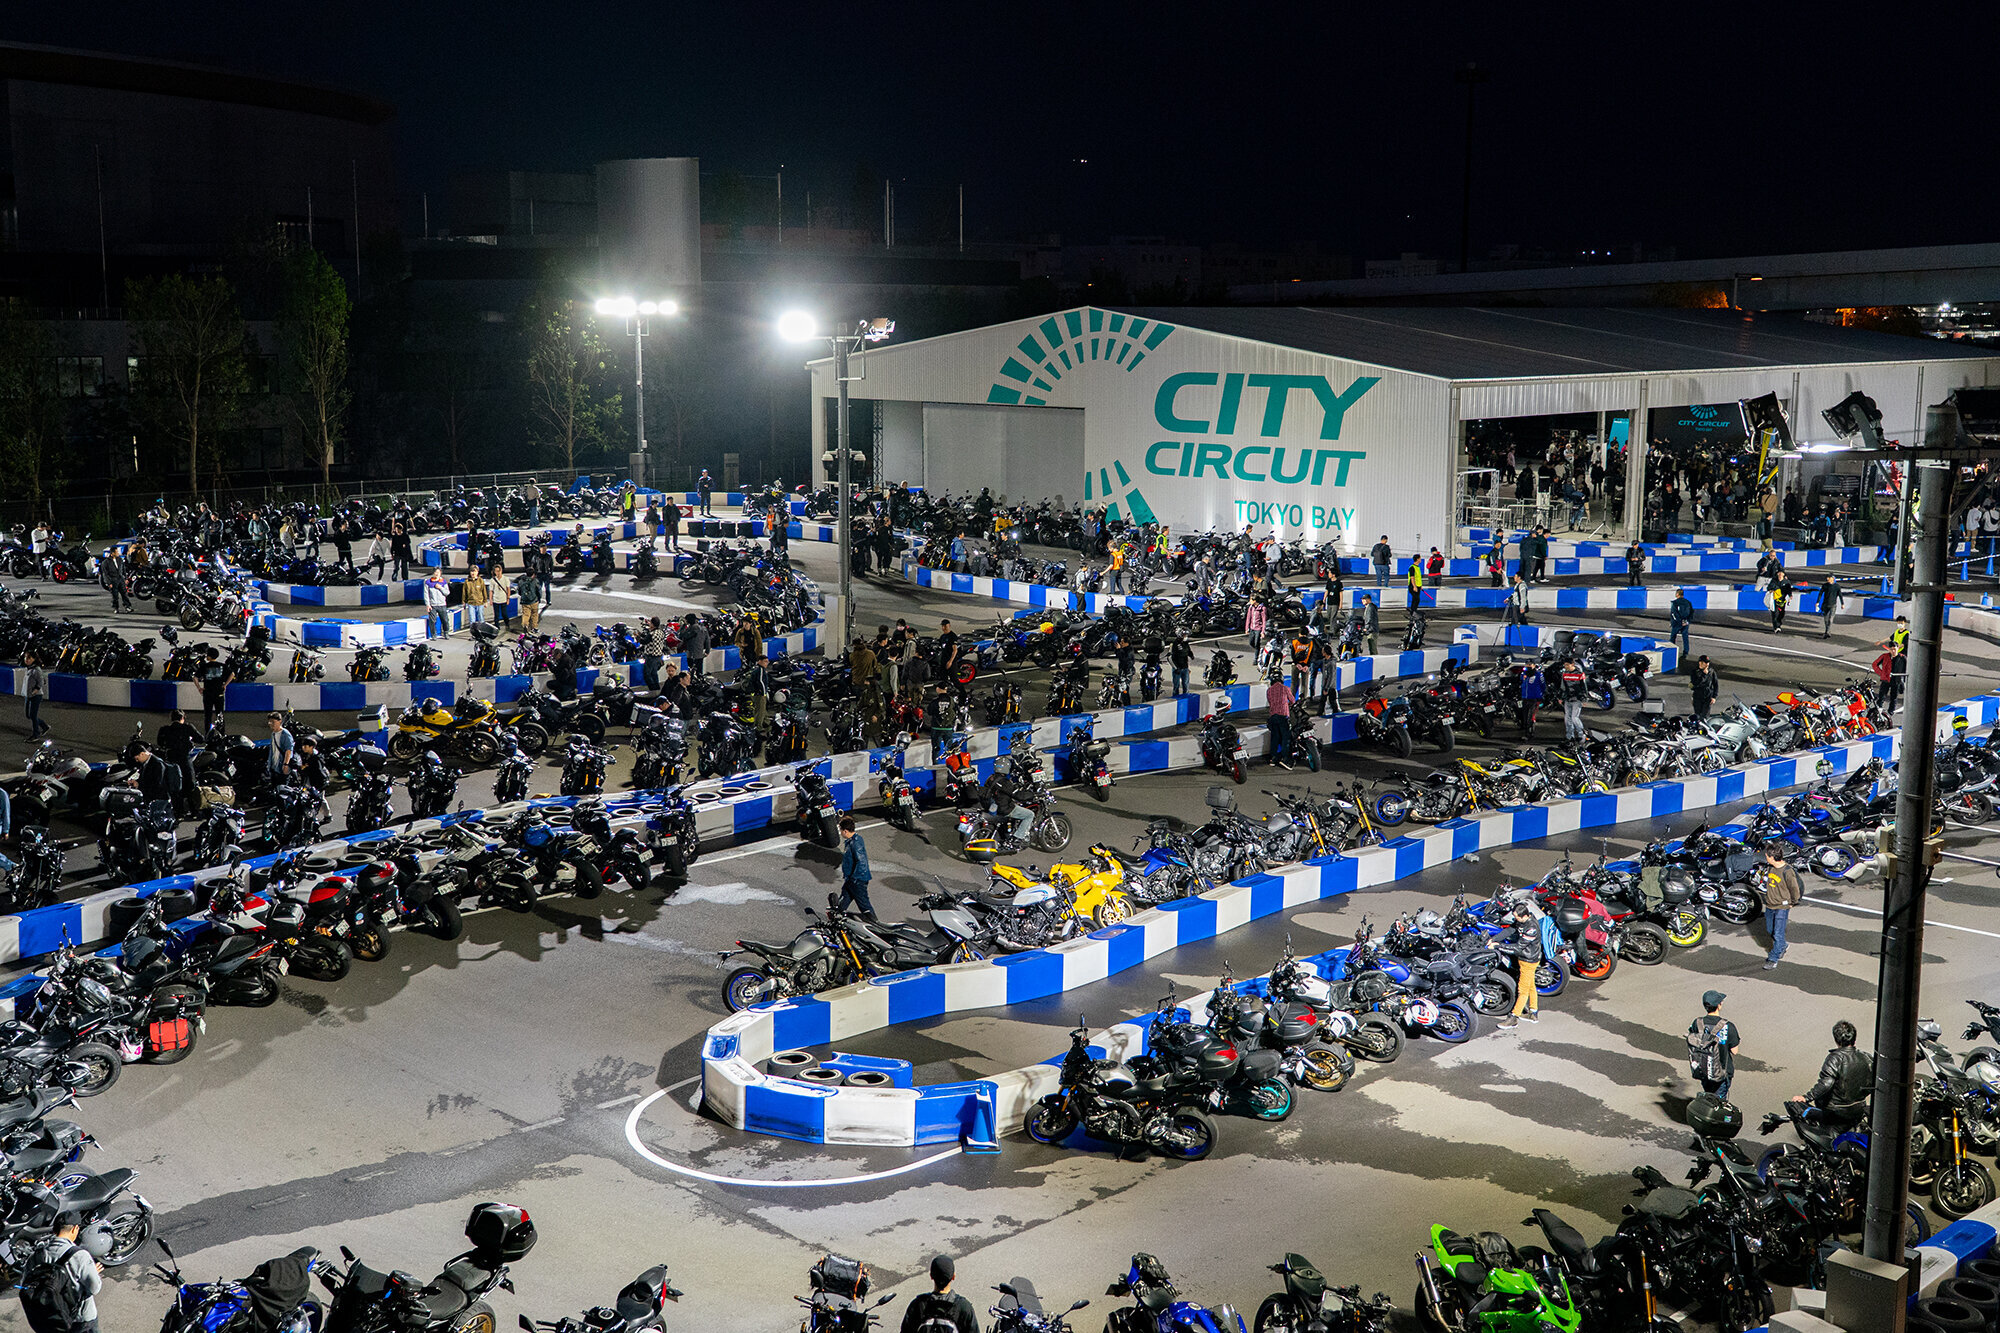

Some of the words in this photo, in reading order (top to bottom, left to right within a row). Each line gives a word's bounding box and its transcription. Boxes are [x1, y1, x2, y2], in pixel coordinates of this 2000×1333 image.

[1154, 371, 1382, 440] CITY
[1145, 441, 1367, 487] CIRCUIT
[1234, 500, 1303, 527] TOKYO
[1311, 505, 1355, 531] BAY
